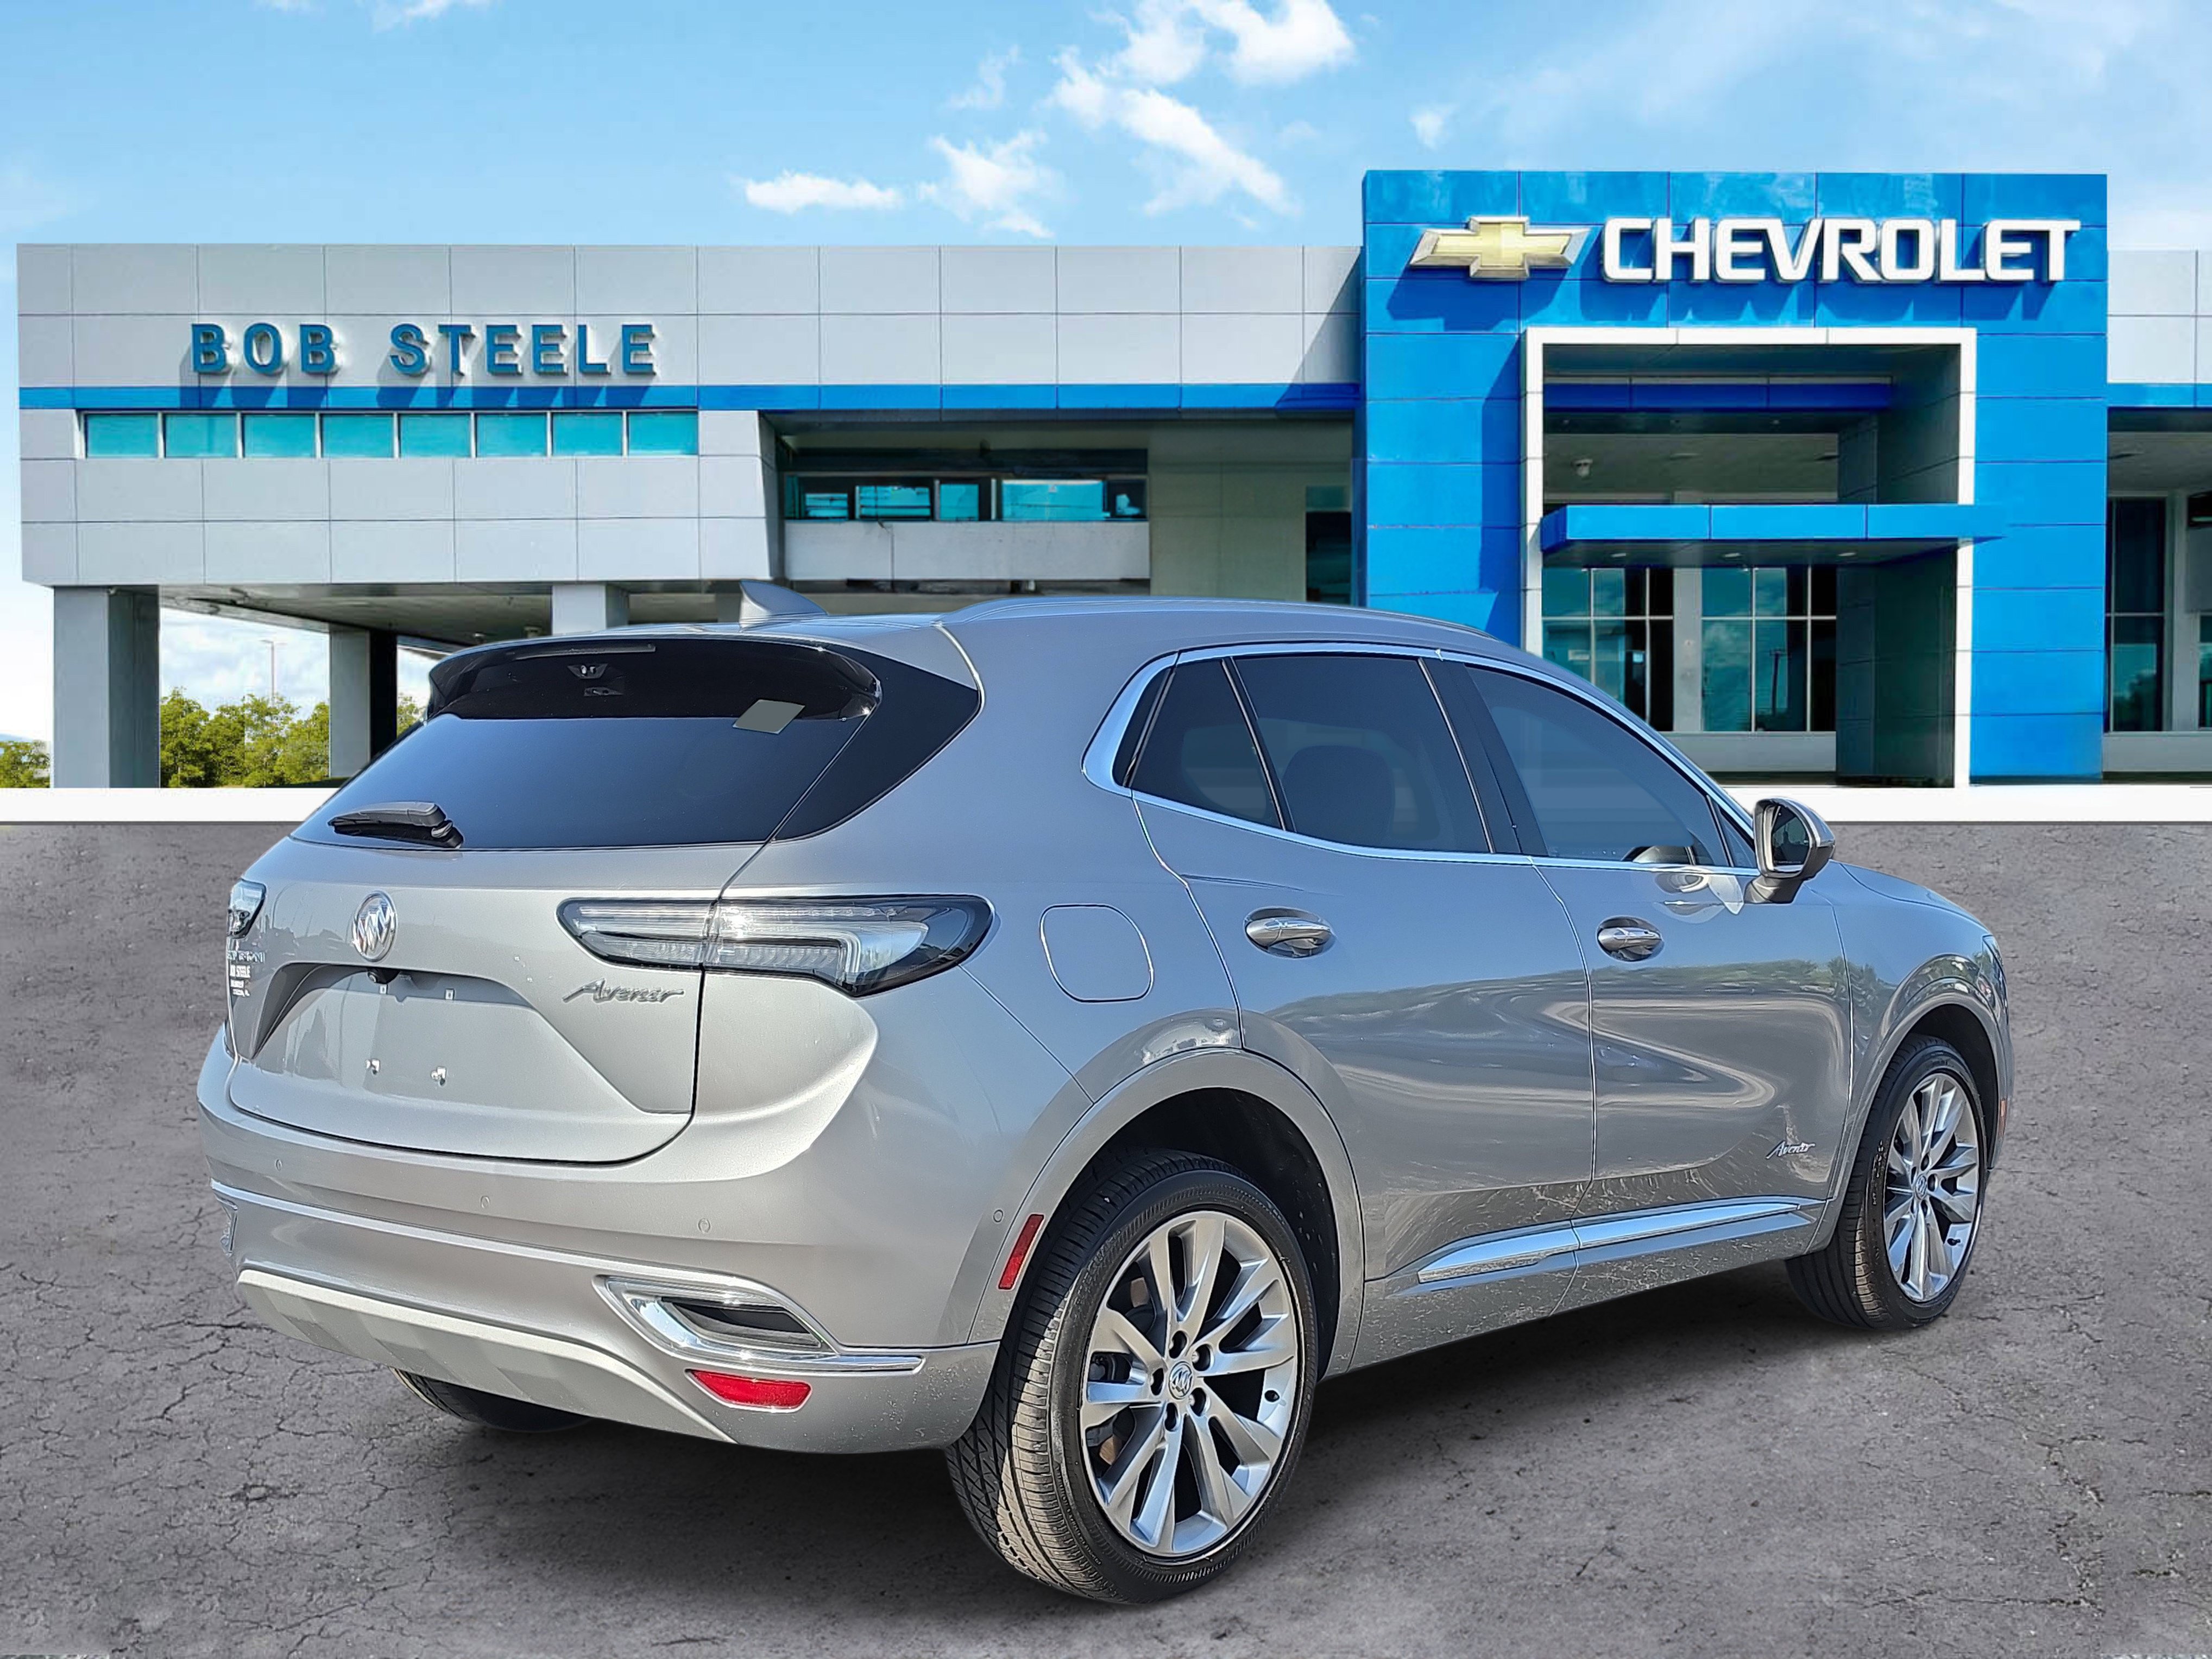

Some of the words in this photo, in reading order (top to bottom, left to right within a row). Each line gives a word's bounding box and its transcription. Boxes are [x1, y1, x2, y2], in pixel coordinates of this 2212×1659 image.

[1602, 218, 2081, 283] CHEVROLET
[191, 323, 338, 375] BOB
[389, 323, 656, 376] STEELE
